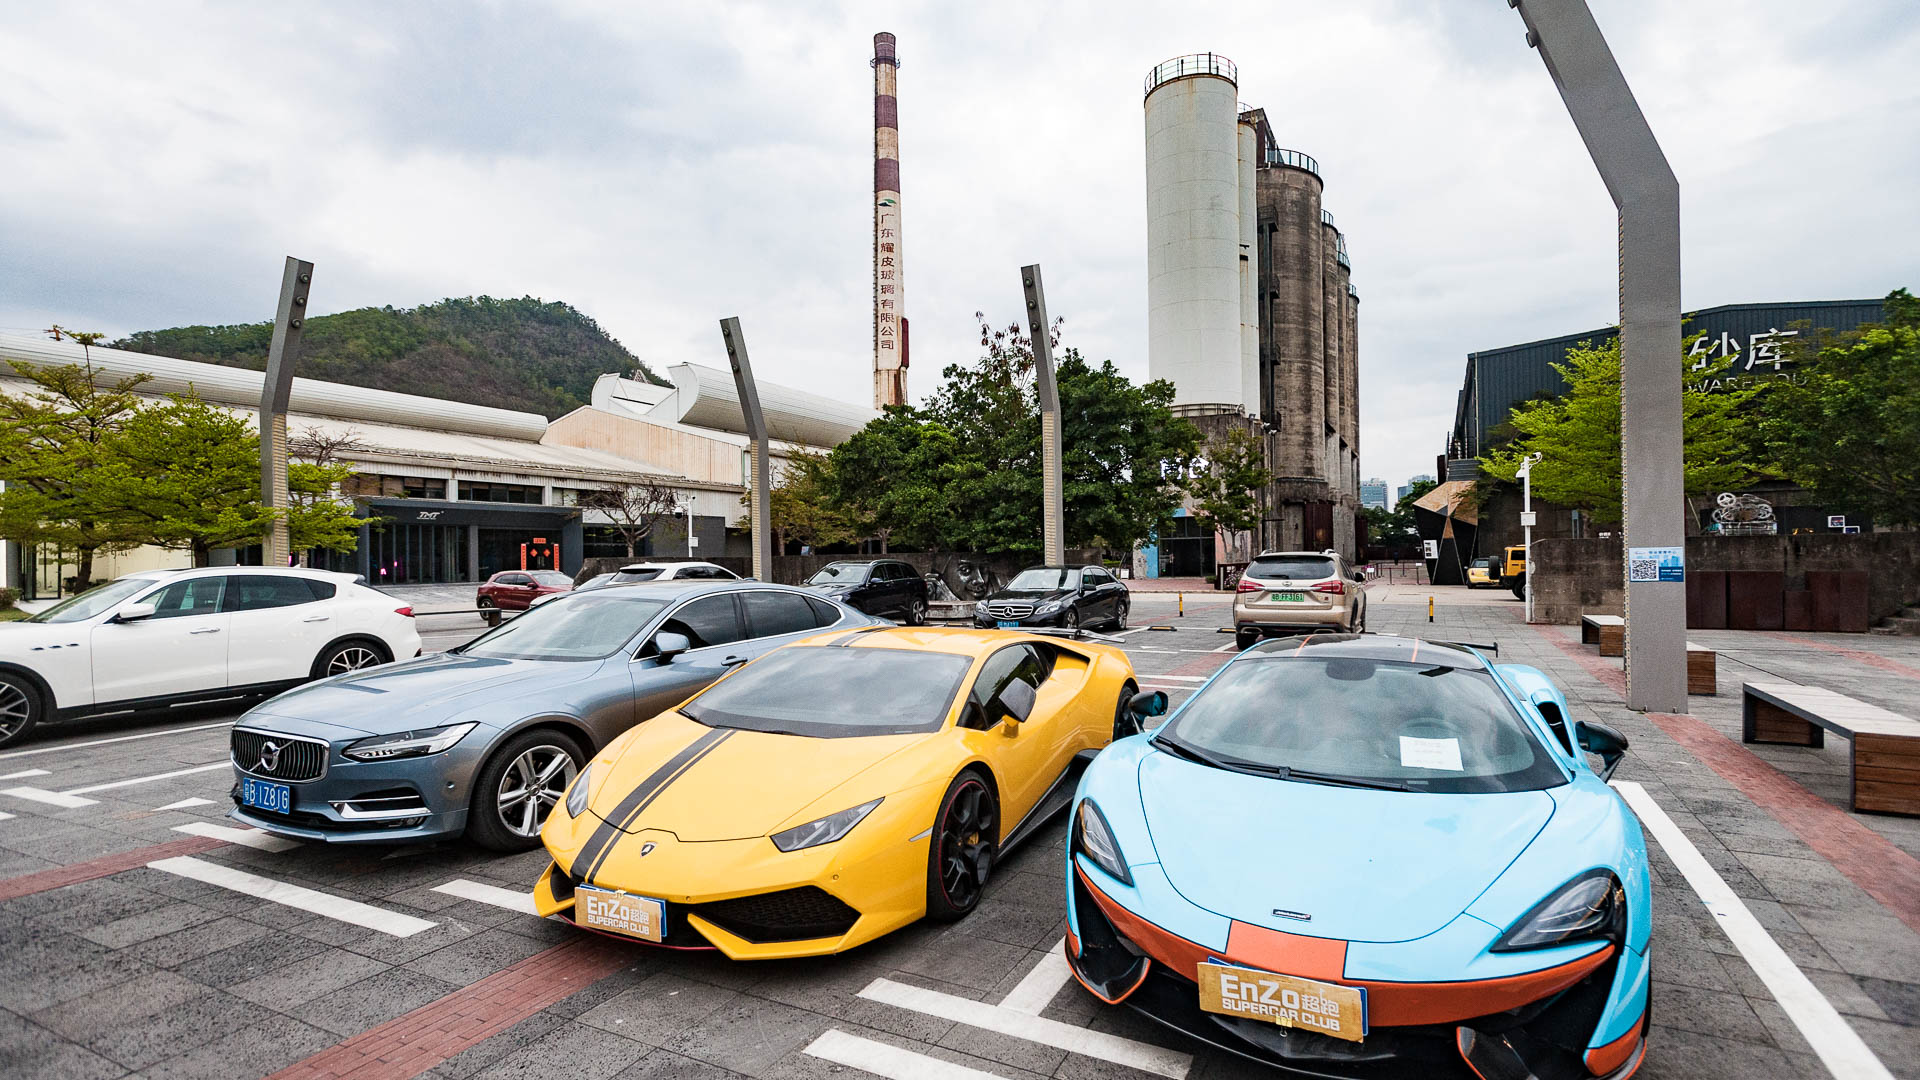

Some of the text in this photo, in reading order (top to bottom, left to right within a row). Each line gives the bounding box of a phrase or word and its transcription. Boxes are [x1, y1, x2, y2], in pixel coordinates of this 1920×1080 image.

[880, 213, 895, 350] 广东耀皮玻璃有限公司
[587, 896, 629, 921] EnZo
[588, 914, 649, 934] SUPERCAR CLUB
[1220, 974, 1299, 1010] EnZo
[1222, 998, 1340, 1032] SUPERCAR CLUB
